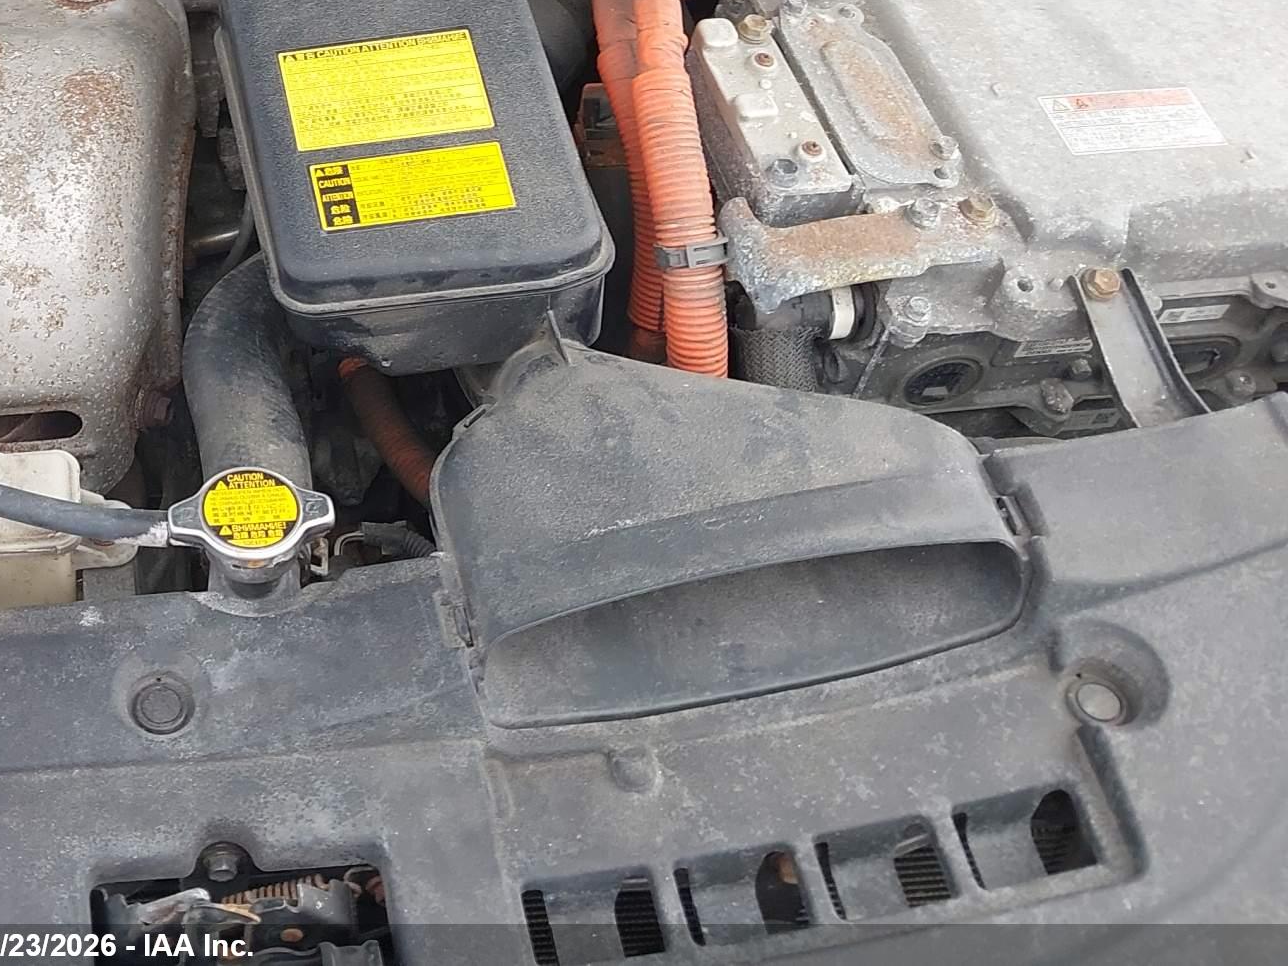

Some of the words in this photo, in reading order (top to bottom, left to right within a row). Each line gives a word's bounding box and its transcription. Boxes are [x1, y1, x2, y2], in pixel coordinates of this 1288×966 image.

[316, 45, 361, 58] CAUTION
[361, 38, 417, 53] ATTENTION
[318, 177, 351, 189] CAUTION
[226, 472, 264, 482] CAUTION
[228, 479, 276, 489] ATTENTION
